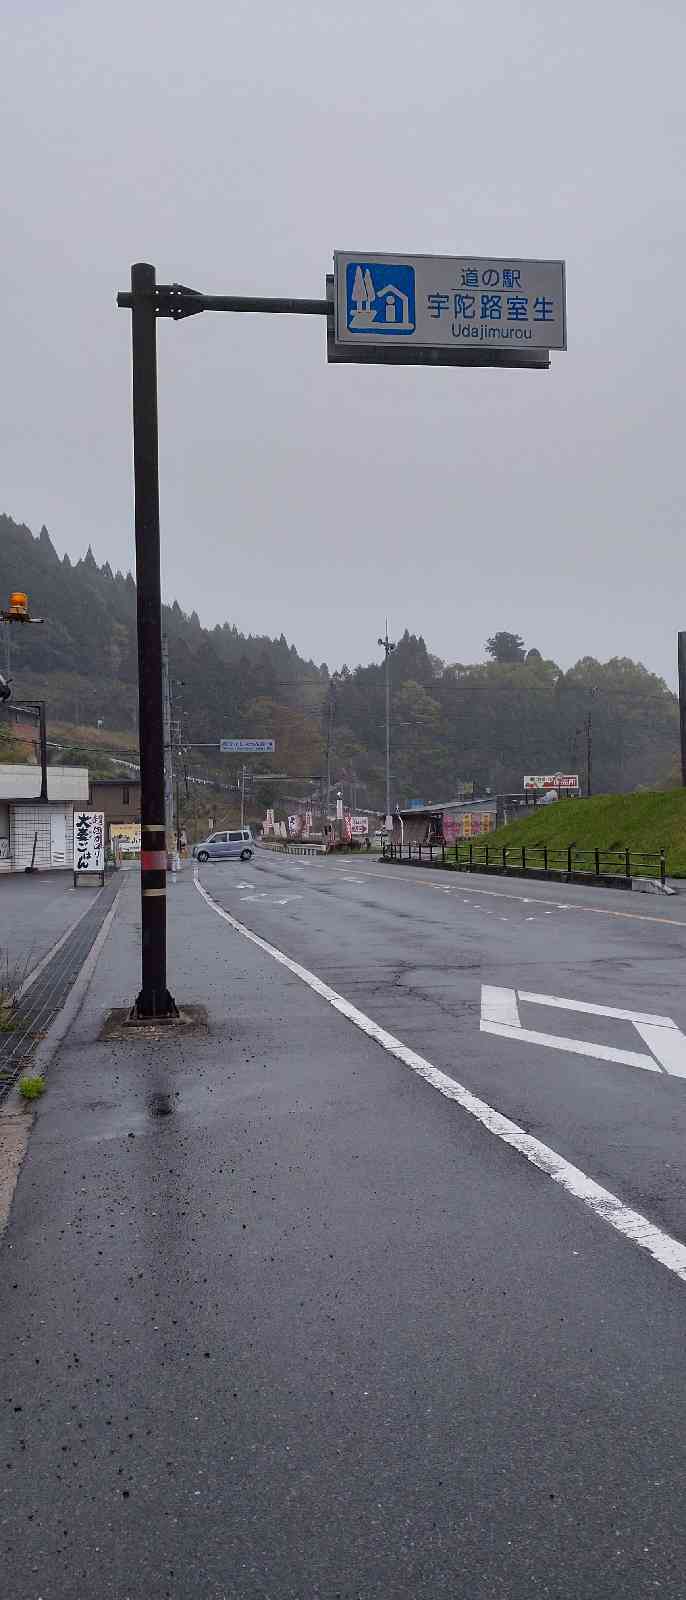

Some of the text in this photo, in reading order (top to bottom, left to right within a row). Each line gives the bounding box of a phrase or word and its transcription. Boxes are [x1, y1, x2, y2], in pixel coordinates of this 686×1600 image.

[460, 267, 521, 289] 道の駅
[426, 292, 556, 323] 宇陀路室生
[451, 323, 533, 341] Udajimurou
